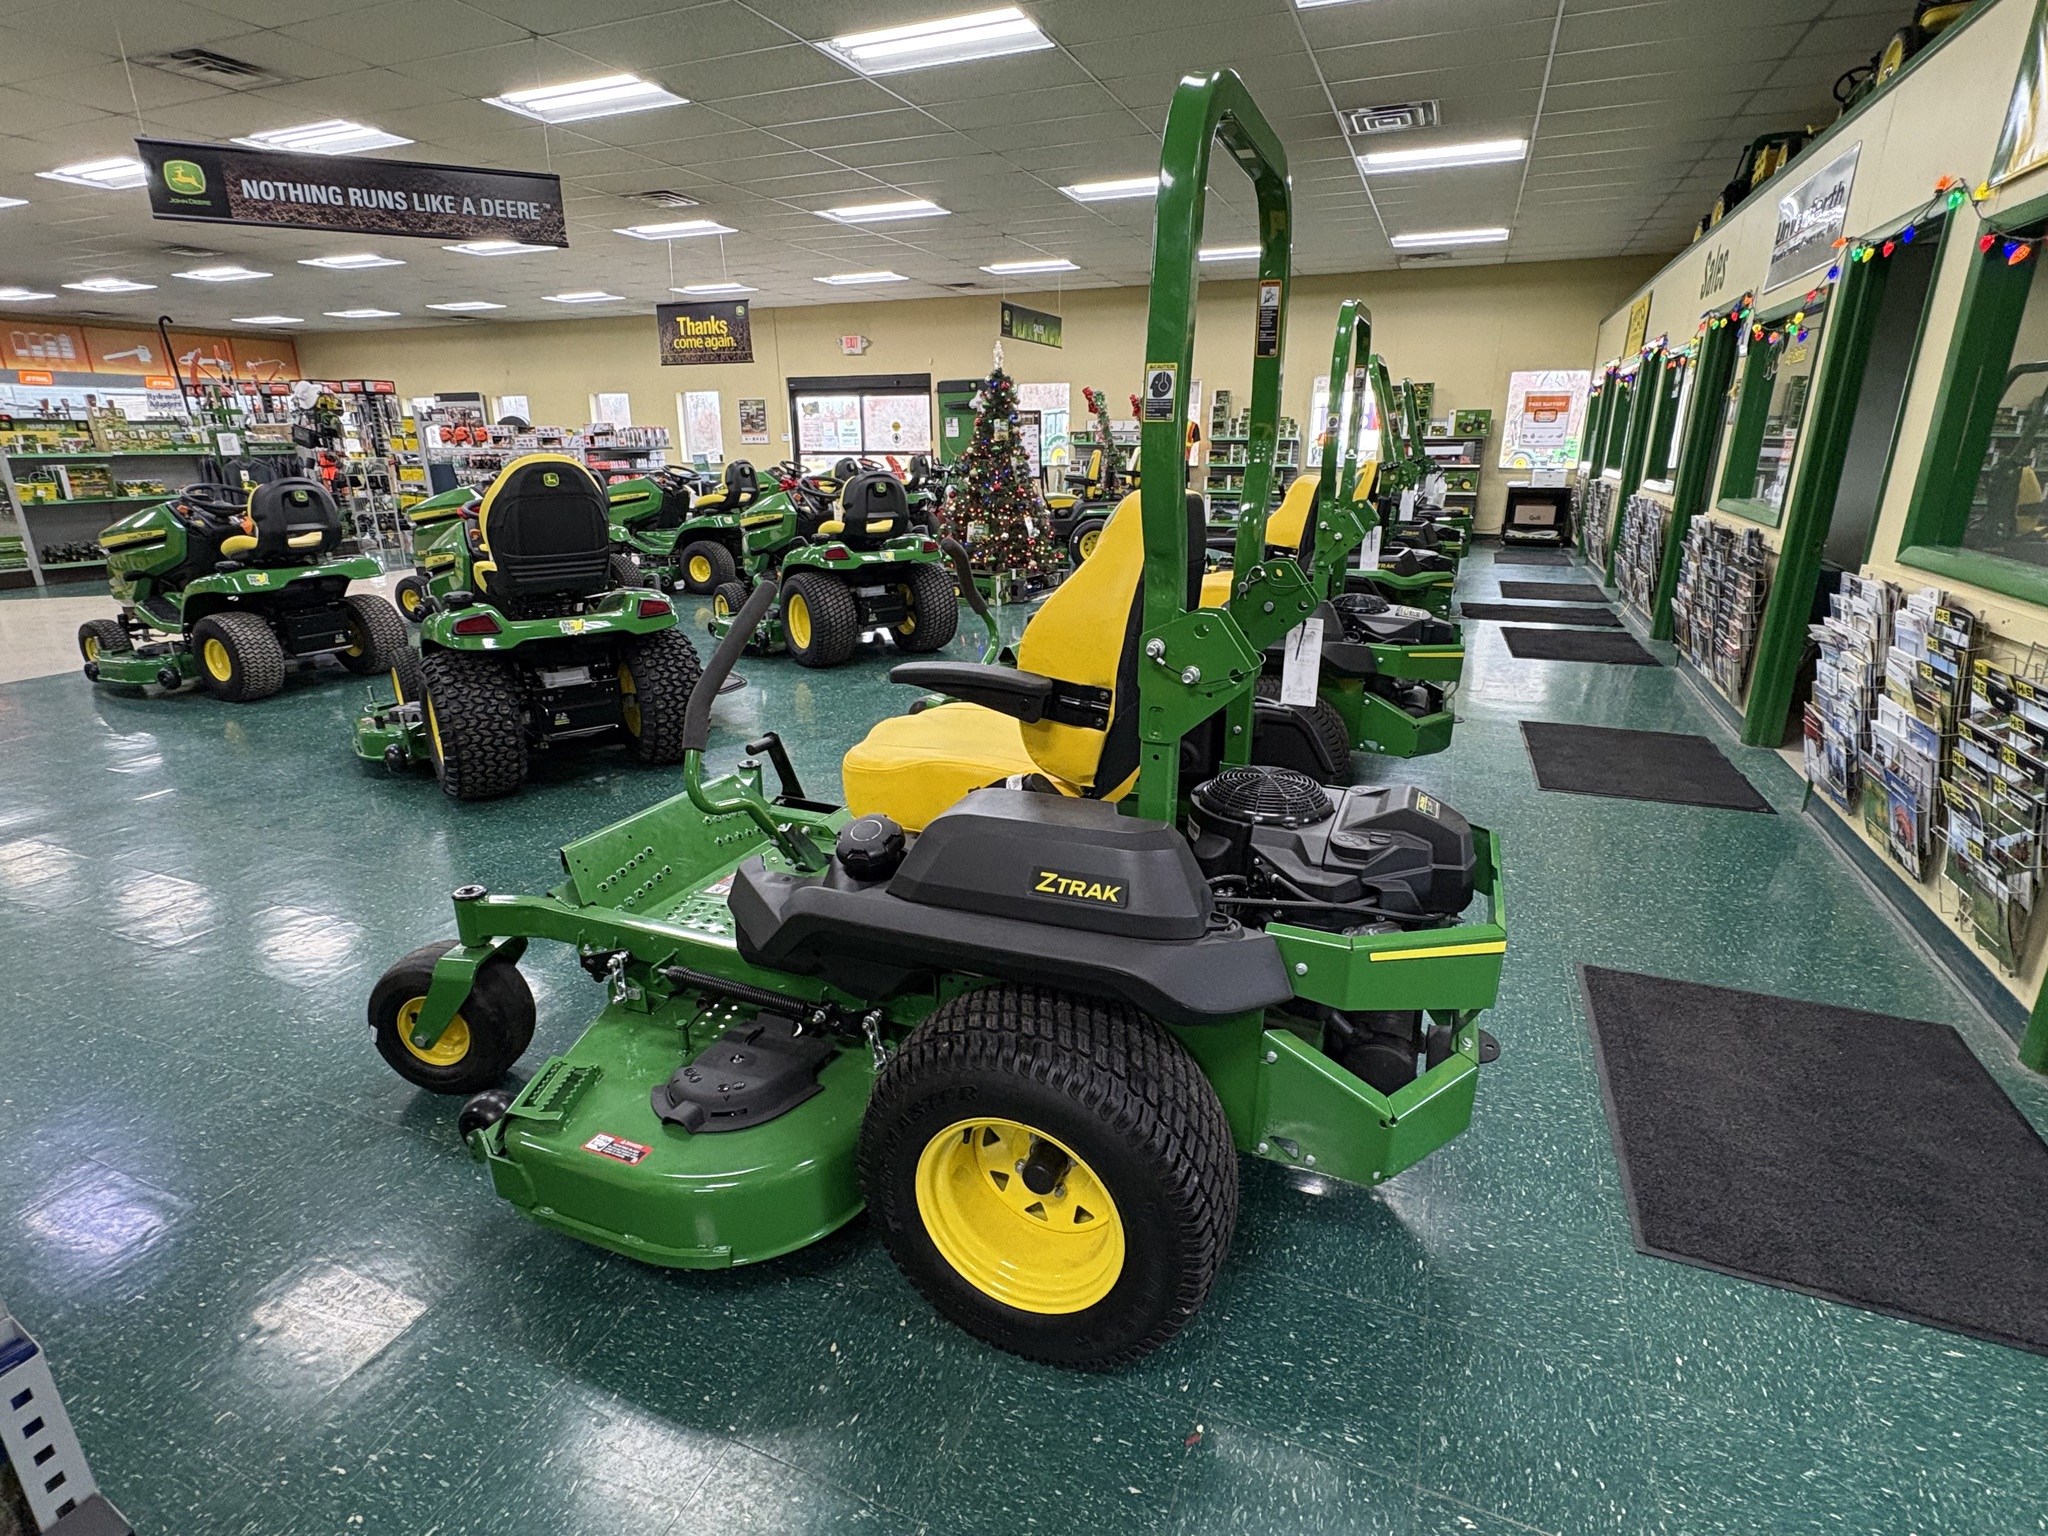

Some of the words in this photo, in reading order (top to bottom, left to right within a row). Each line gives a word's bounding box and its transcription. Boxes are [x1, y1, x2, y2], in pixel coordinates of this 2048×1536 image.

[240, 178, 345, 207] NOTHING
[347, 187, 409, 211] RUNS
[412, 192, 457, 214] LIKE
[462, 197, 477, 216] A
[1700, 244, 1730, 300] Sales
[675, 314, 729, 336] Thanks
[673, 337, 704, 349] come
[25, 375, 50, 383] STIHL
[1377, 562, 1397, 570] TRAK
[1034, 871, 1122, 903] ZTRAK
